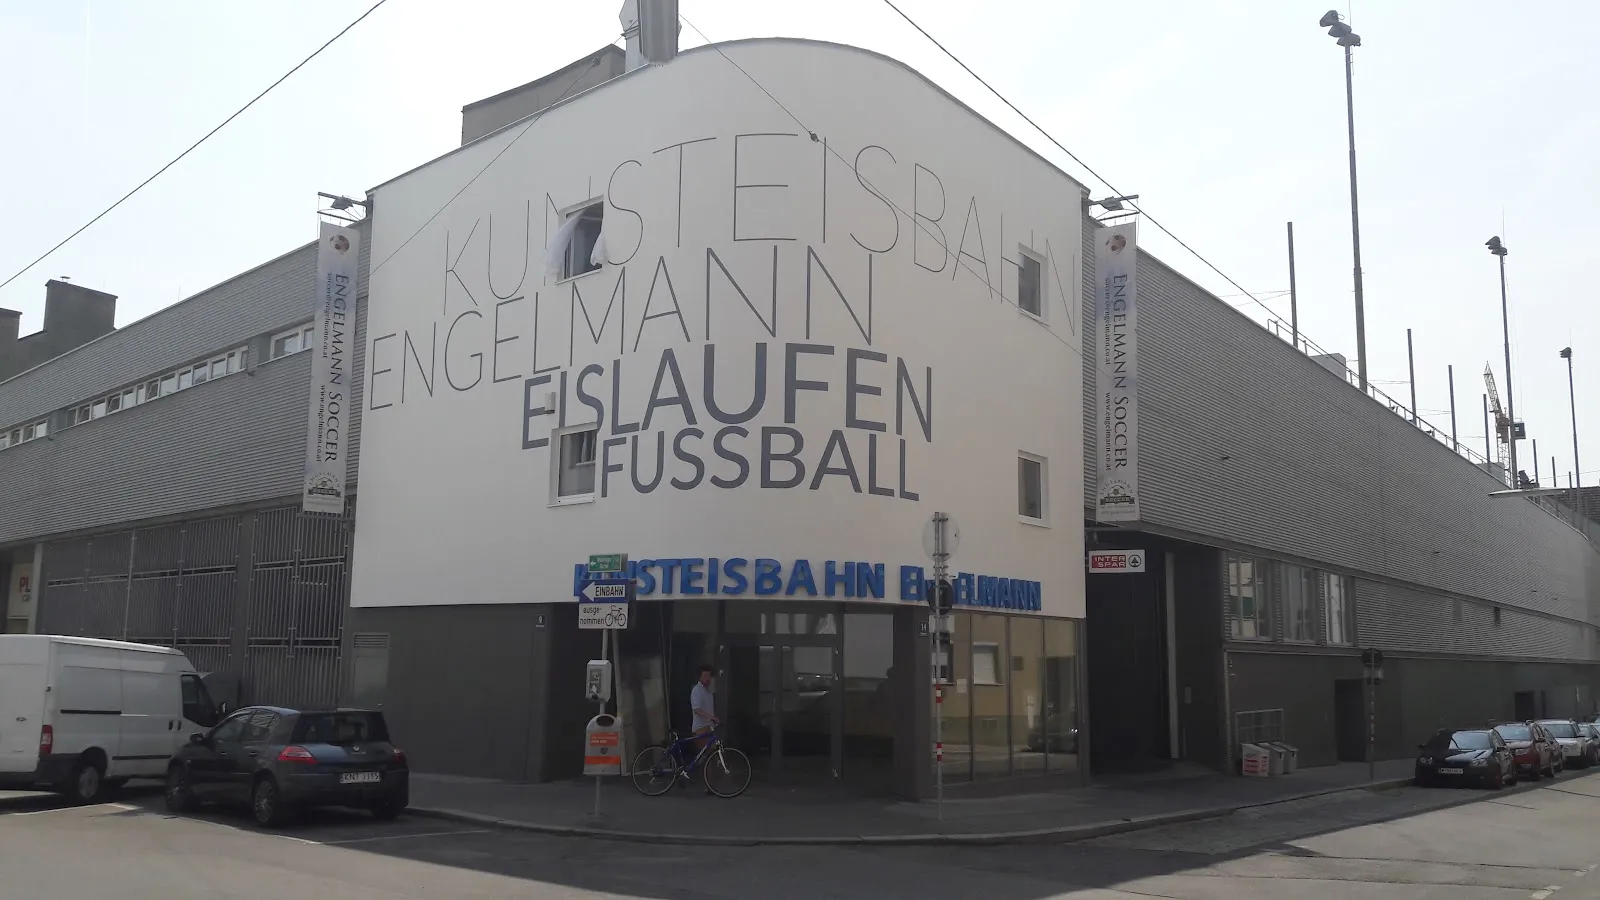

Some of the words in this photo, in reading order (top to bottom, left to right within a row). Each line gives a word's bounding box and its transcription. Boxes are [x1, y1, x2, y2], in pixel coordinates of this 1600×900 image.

[329, 273, 349, 385] ENGELMANN
[369, 245, 873, 411] ENGELMANN
[1113, 274, 1128, 389] ENGELMANN
[316, 385, 327, 462] www.engelmann.co.at
[325, 391, 343, 462] SOCCER
[522, 342, 932, 450] EISLAUFEN
[1104, 392, 1112, 471] www.engelmann.co.at
[1114, 396, 1129, 469] SOCCER
[601, 425, 920, 501] FUSSBALL
[573, 557, 885, 598] KSTEISBAHN
[900, 565, 1042, 611] EELMANN
[595, 585, 624, 597] EINBAHN
